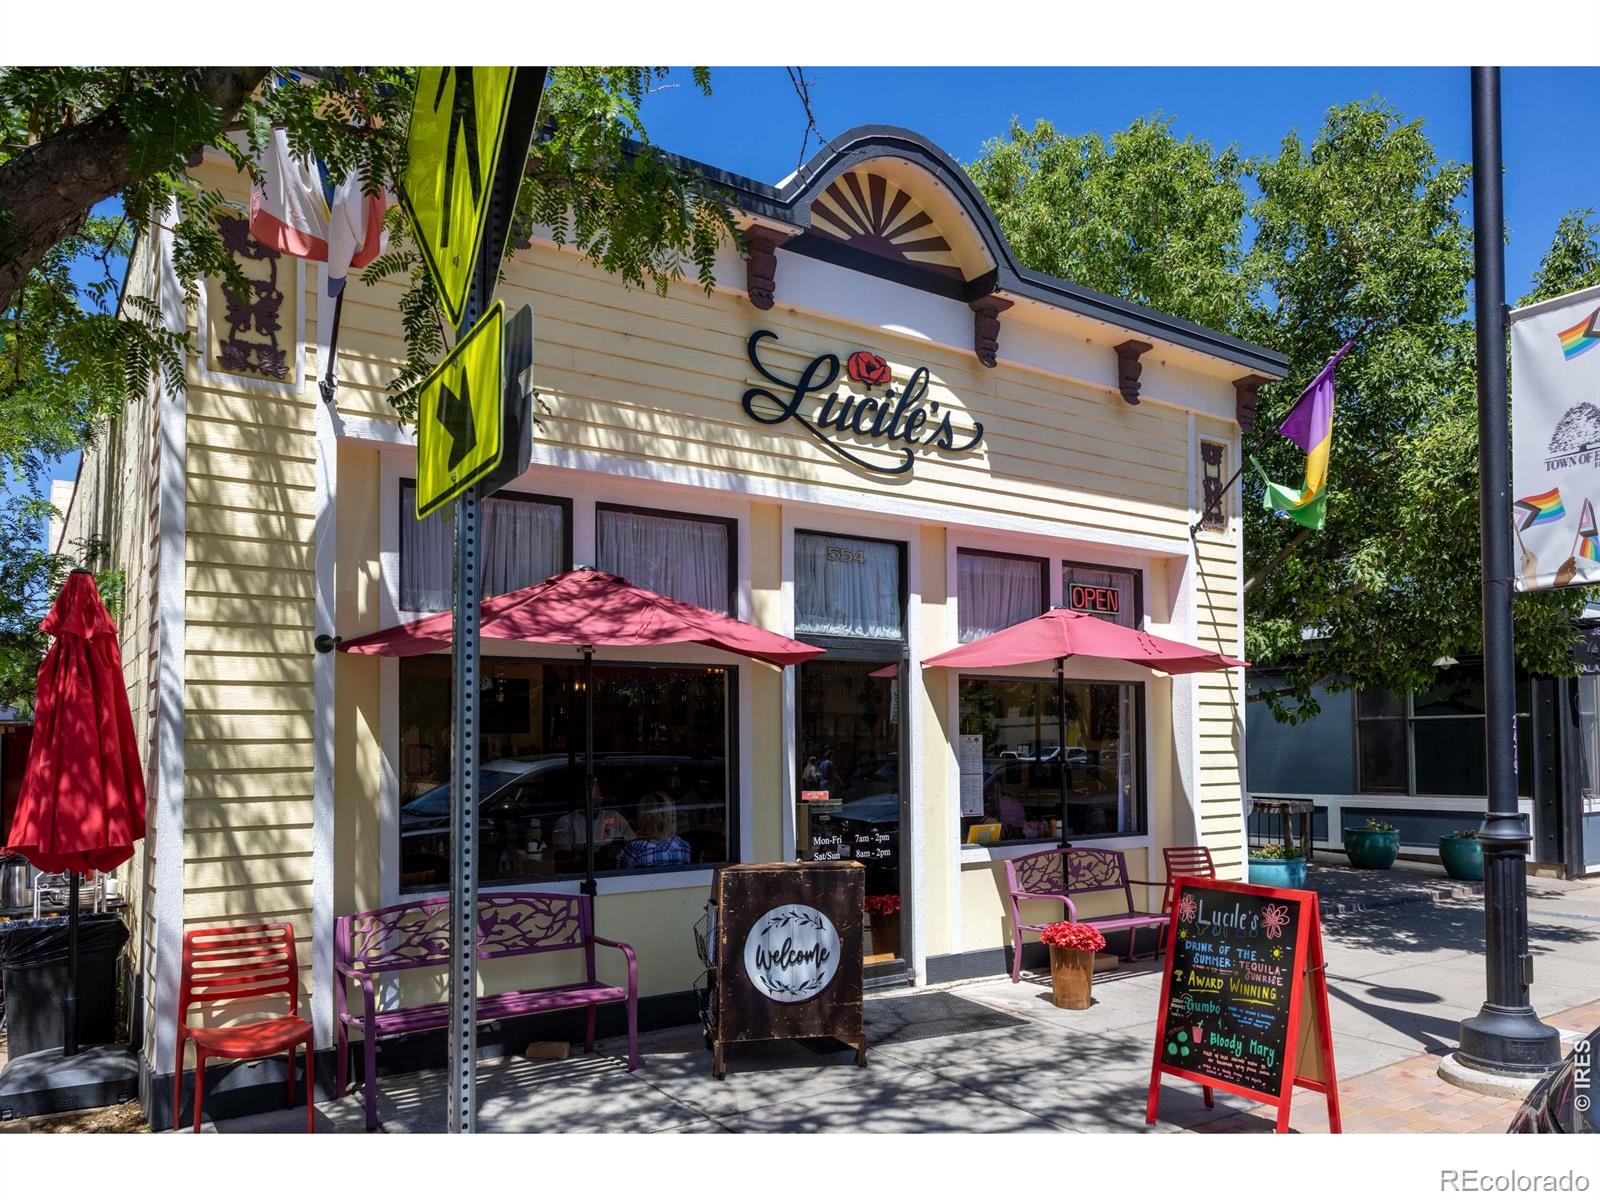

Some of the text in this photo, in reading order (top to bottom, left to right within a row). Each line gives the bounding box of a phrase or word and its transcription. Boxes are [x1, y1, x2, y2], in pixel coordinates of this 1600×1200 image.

[742, 330, 984, 474] Lucile's
[1544, 456, 1577, 472] TOWN
[1579, 452, 1593, 465] OF
[827, 546, 865, 565] 554
[1073, 586, 1118, 611] OPEN
[813, 835, 843, 846] Mon-Fri
[855, 834, 870, 843] 7am
[875, 833, 890, 844] 2pm
[814, 851, 841, 861] Sat/Sun
[856, 849, 871, 858] 8am
[876, 848, 891, 859] 2pm
[756, 937, 830, 971] Welcome
[1185, 940, 1257, 961] DRINK OF THE
[1187, 970, 1278, 1000] AWARD WINNING
[1244, 971, 1284, 986] SUNRISE
[1186, 998, 1221, 1014] Gumbo
[1210, 1032, 1243, 1057] Bloody
[1249, 1039, 1275, 1067] Mary
